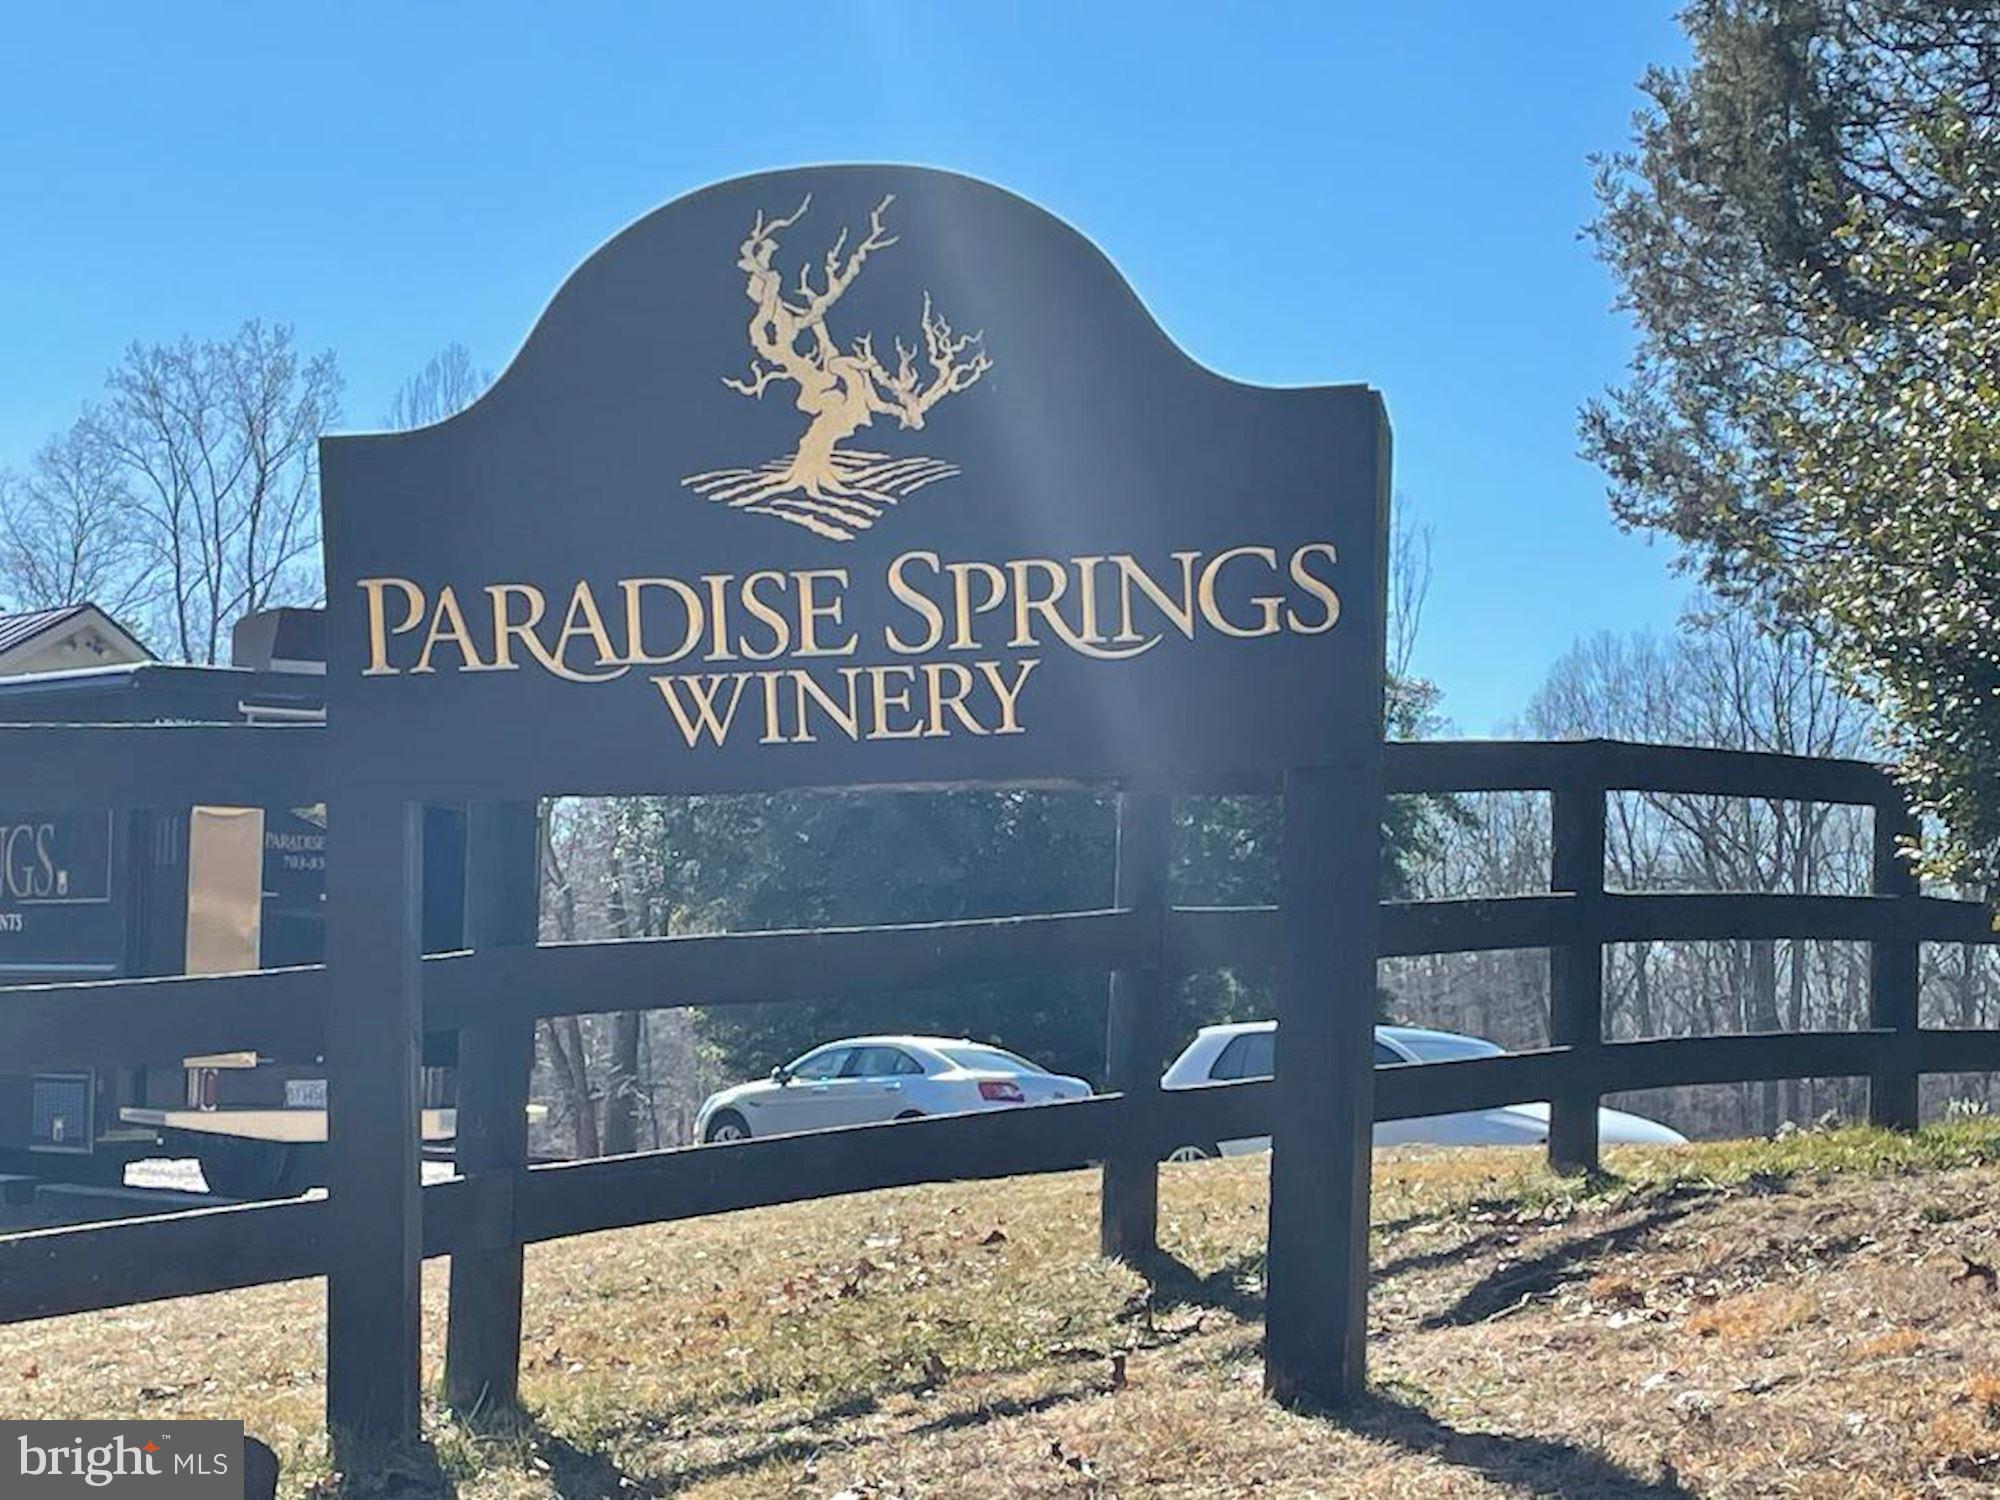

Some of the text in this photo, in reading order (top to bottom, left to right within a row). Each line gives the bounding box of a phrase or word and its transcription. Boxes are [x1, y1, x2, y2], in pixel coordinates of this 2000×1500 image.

[356, 542, 1342, 683] PARADISE SPRINGS
[649, 658, 1041, 749] WINERY
